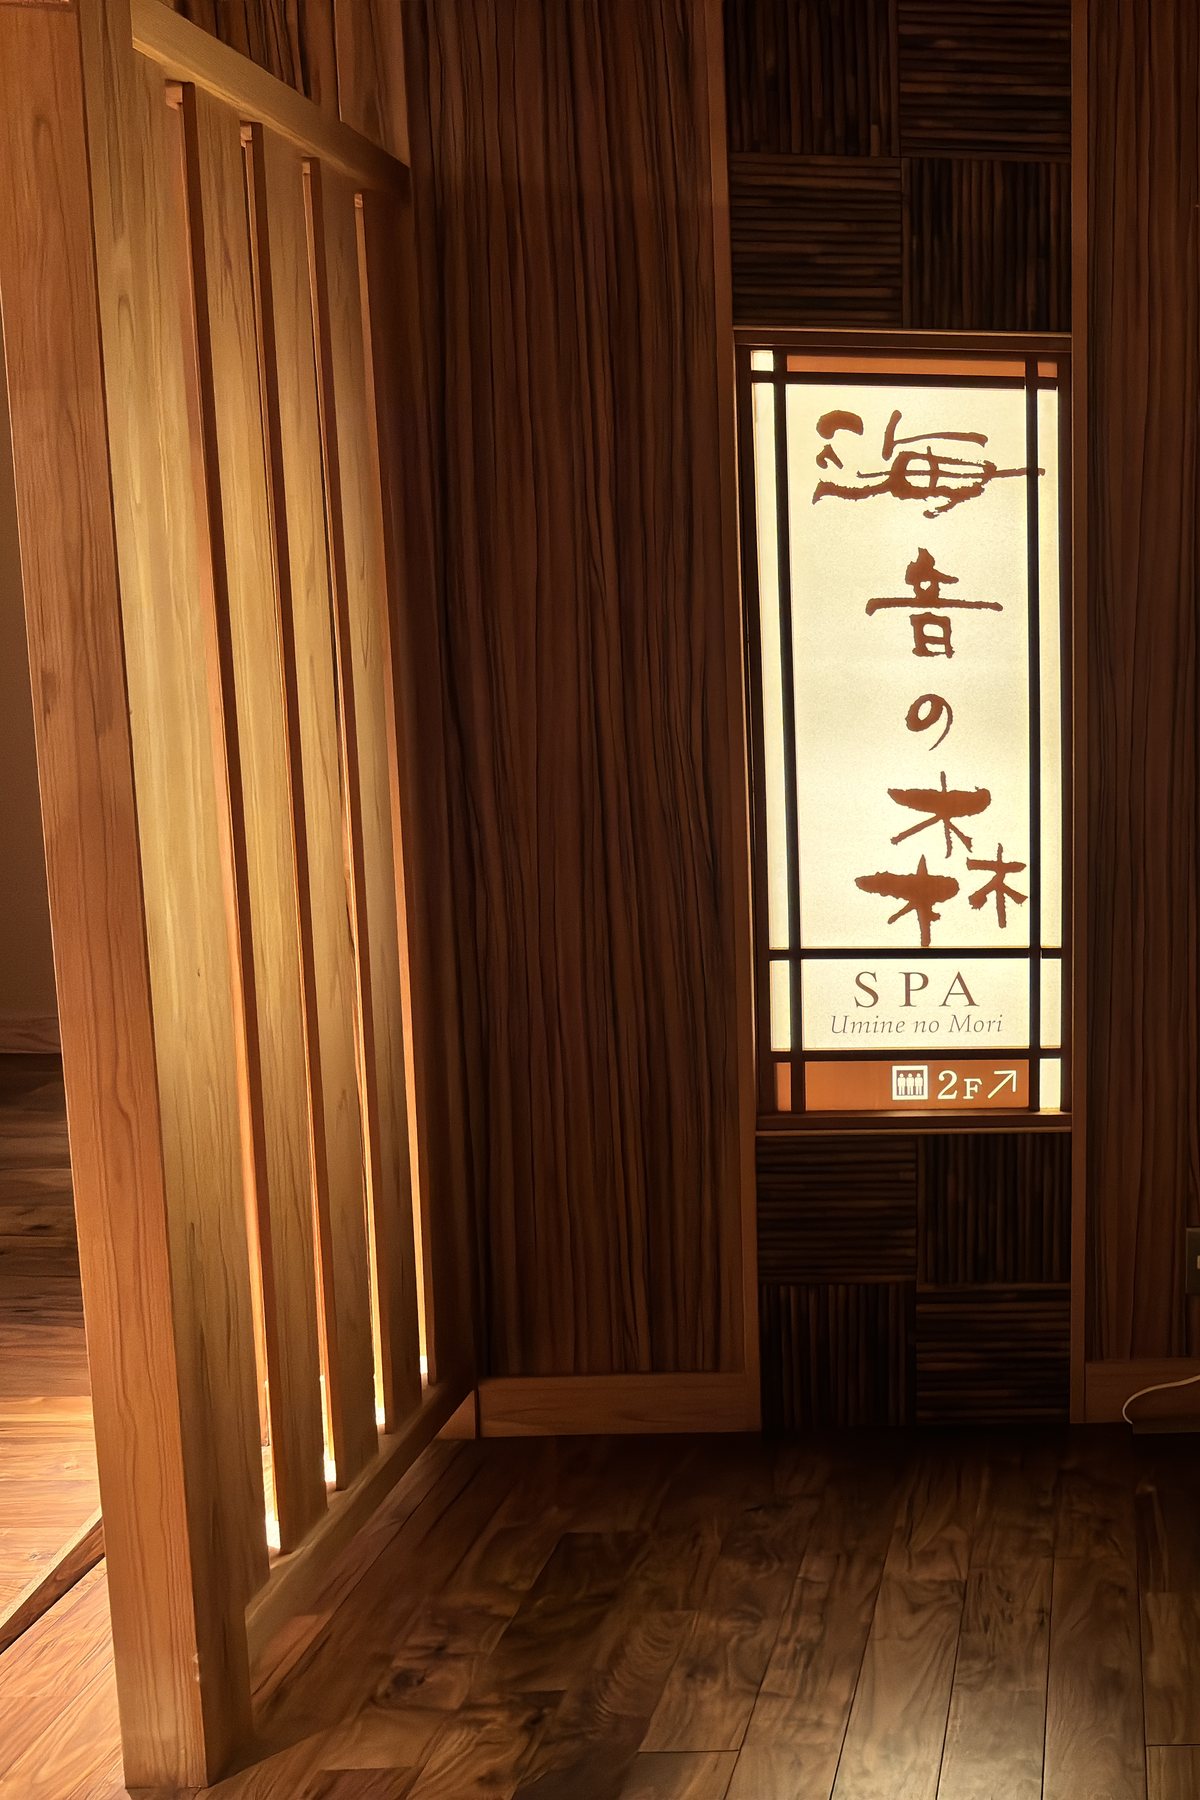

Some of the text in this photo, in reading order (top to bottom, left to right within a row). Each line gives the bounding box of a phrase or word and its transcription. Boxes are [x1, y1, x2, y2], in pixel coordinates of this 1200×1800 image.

[812, 408, 1046, 948] 海音の森
[854, 971, 980, 1008] SPA
[831, 1014, 1003, 1034] Umine no Mori
[937, 1070, 982, 1100] 2F
